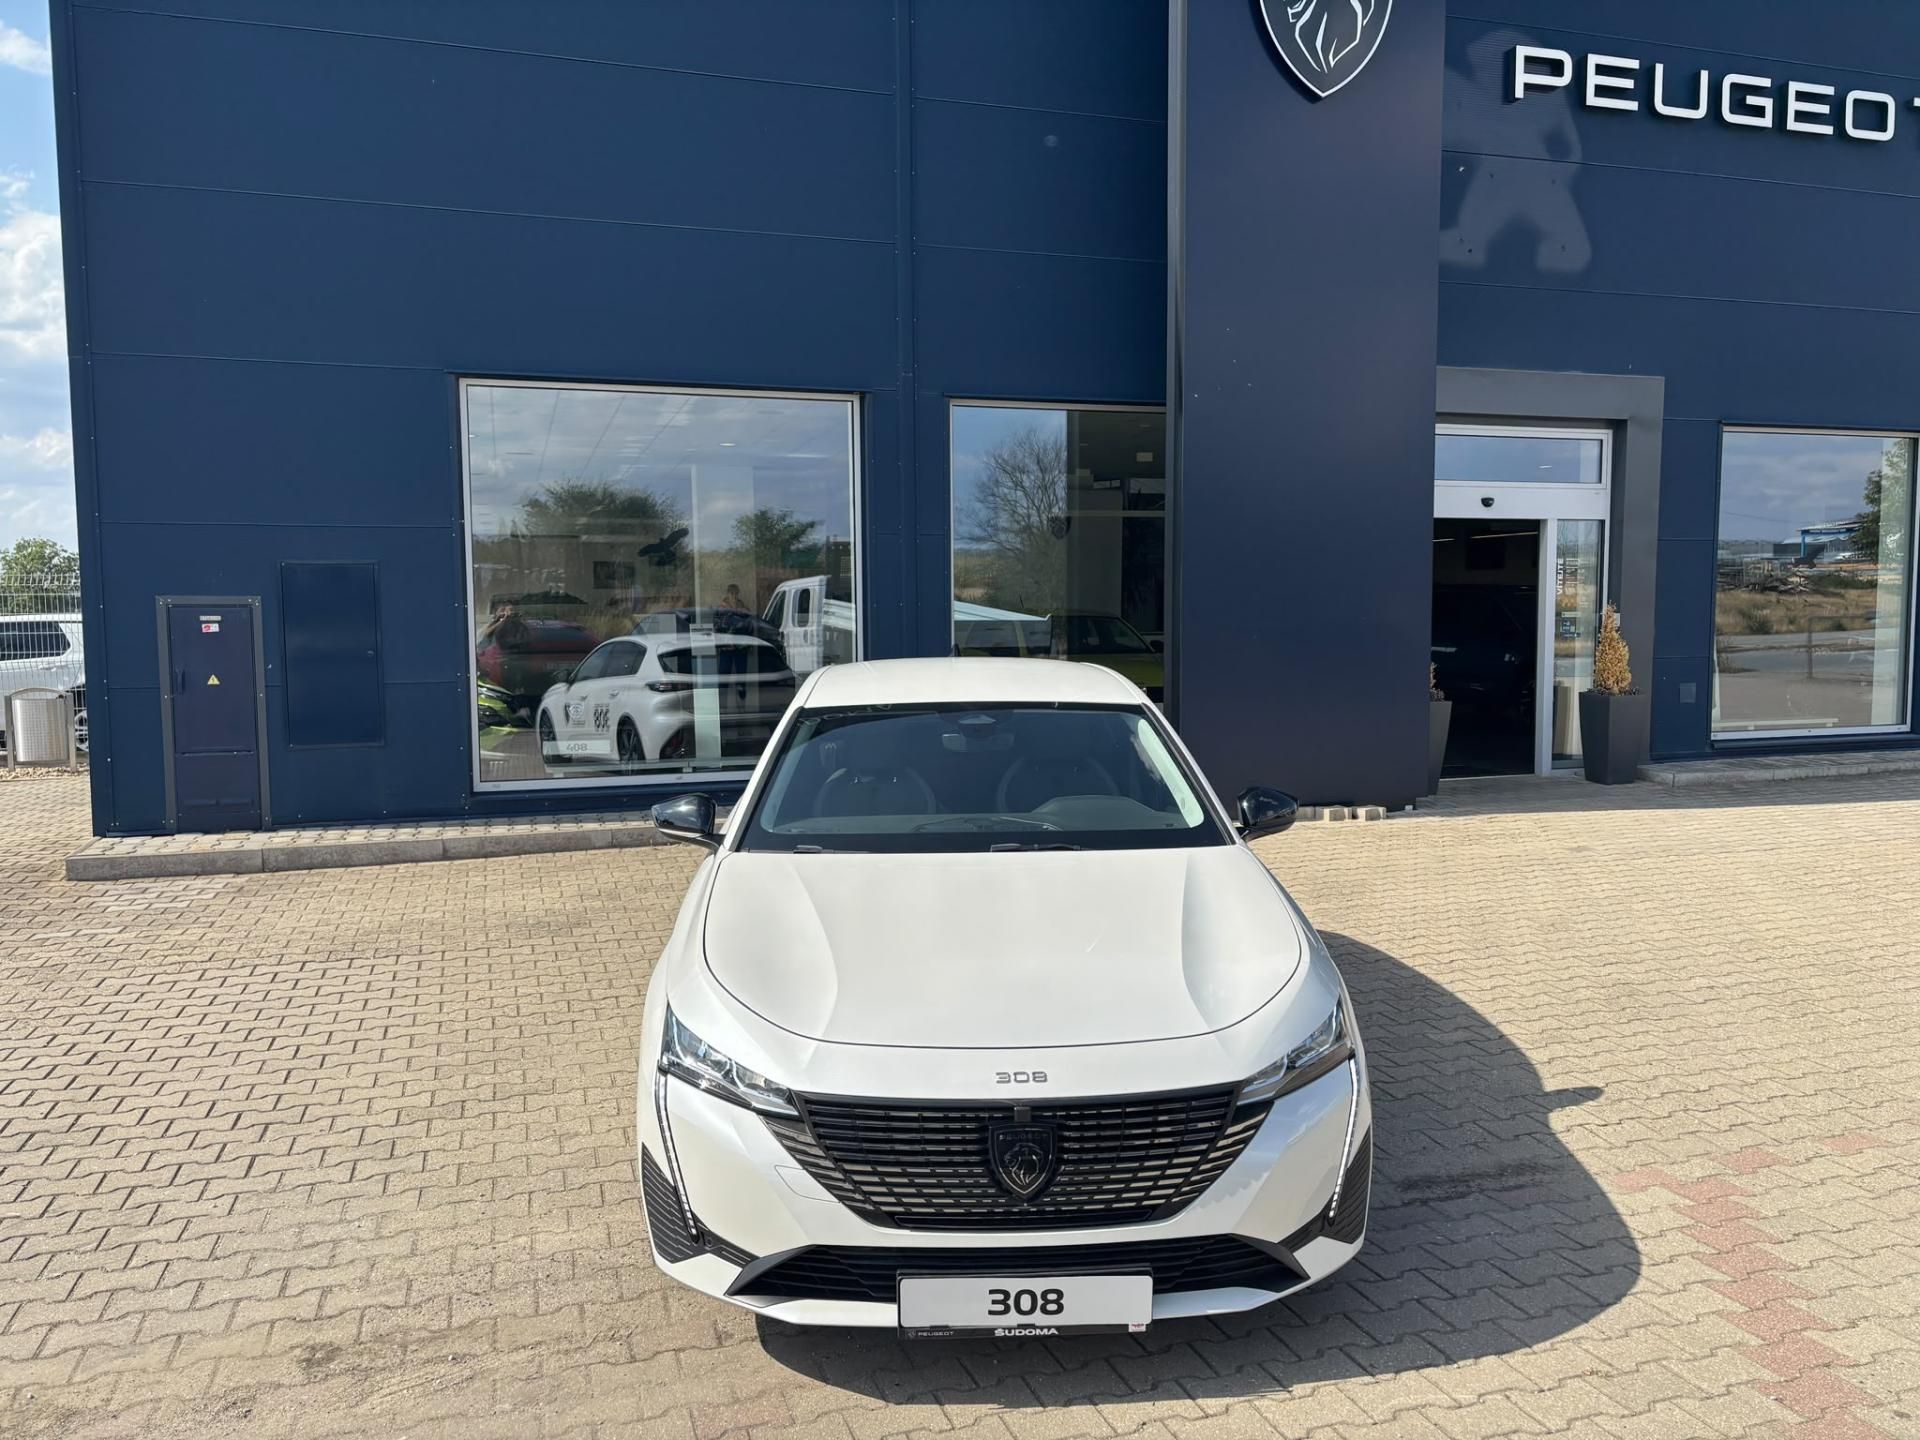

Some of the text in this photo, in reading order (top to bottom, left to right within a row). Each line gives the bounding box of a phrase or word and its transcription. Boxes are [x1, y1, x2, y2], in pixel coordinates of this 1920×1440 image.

[1515, 45, 1920, 141] PEUGEO
[566, 743, 588, 751] 408
[996, 1071, 1047, 1083] 308
[988, 1288, 1064, 1316] 308
